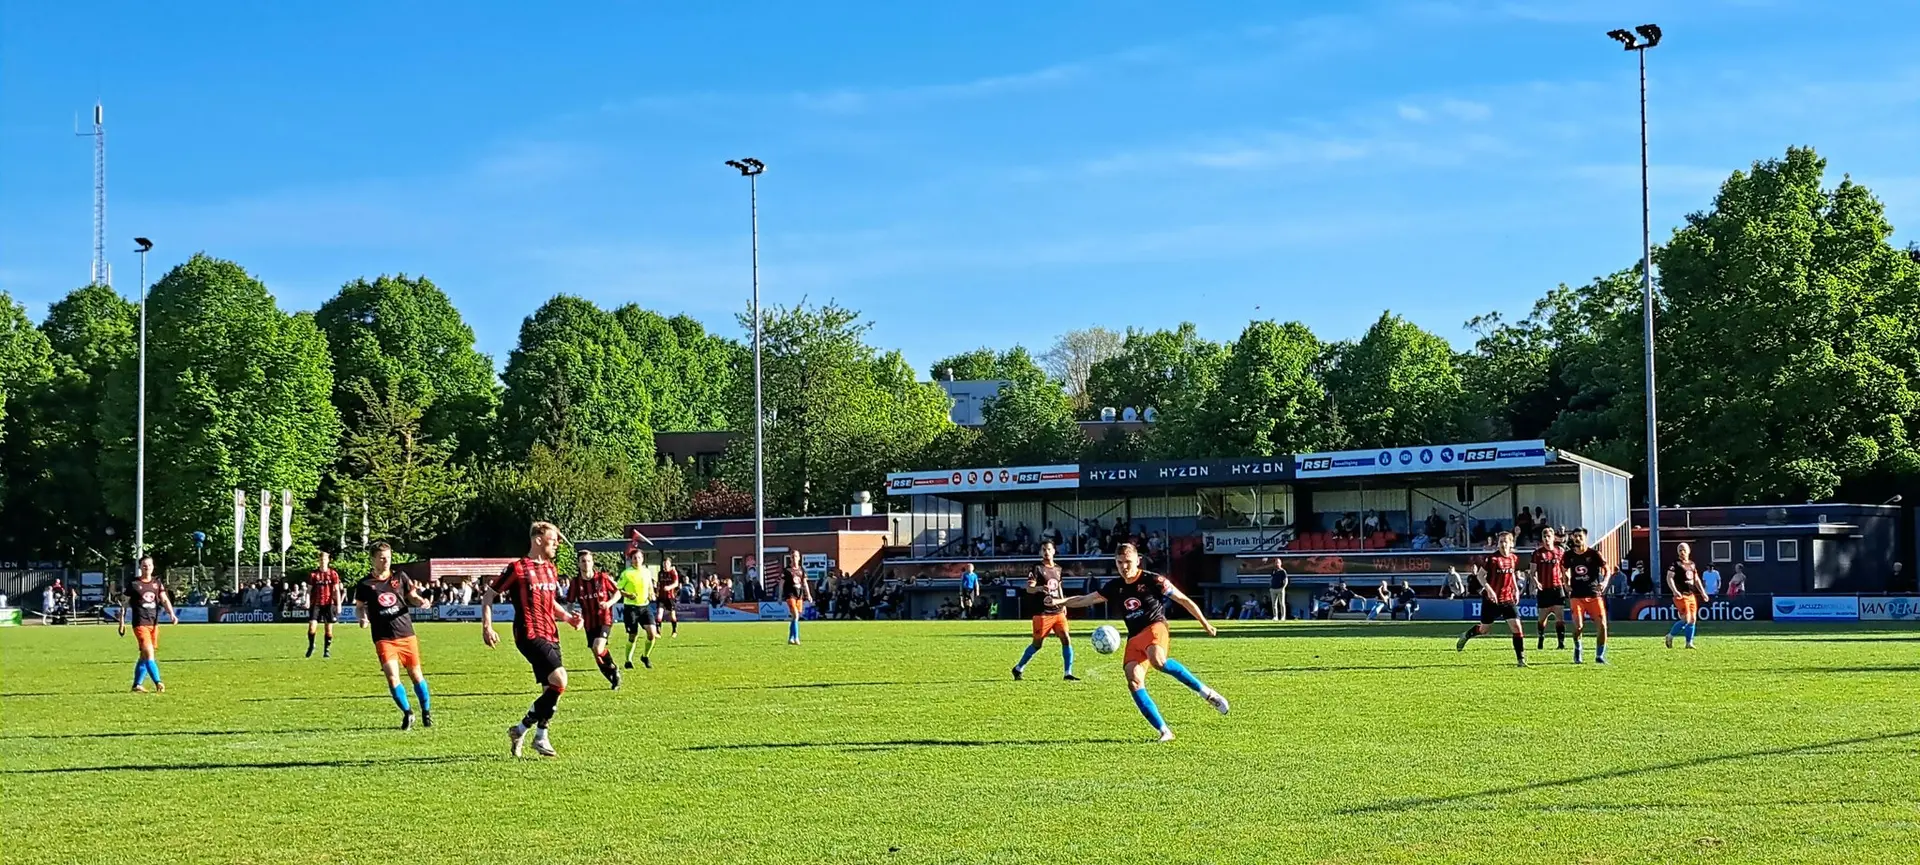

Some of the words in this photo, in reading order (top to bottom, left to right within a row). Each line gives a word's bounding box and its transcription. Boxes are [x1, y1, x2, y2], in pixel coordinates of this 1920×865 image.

[1466, 451, 1494, 460] RSE
[1304, 460, 1329, 469] RSE
[1090, 469, 1137, 480] HYZON
[1159, 466, 1209, 477] HYZON
[1232, 462, 1284, 474] HYZON
[1019, 474, 1039, 482] RSE
[893, 480, 912, 488] RSE
[0, 561, 18, 569] ON
[1401, 557, 1431, 570] 1896
[1472, 602, 1538, 616] Hken
[1651, 601, 1755, 620] intoffice
[225, 609, 274, 622] interoffice
[291, 610, 310, 618] RECLA
